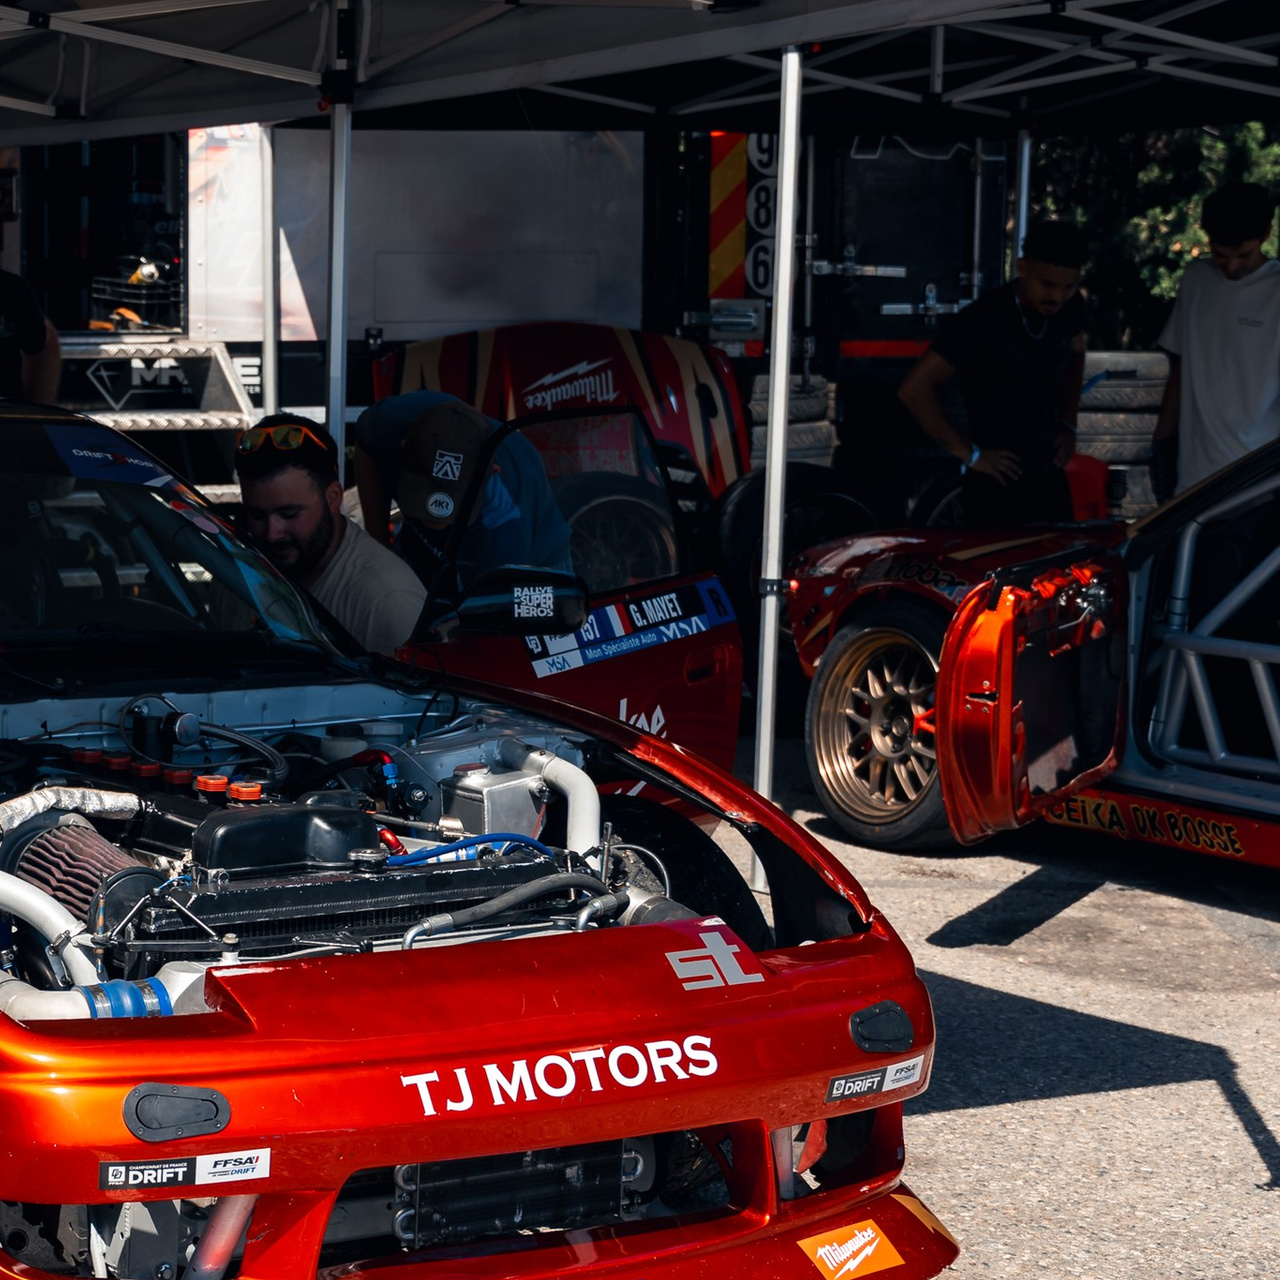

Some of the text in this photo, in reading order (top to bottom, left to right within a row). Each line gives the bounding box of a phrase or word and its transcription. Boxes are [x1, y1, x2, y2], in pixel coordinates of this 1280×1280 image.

[521, 368, 620, 412] Milwaukee
[514, 586, 554, 598] RALLYE
[520, 593, 554, 610] SUPER
[642, 592, 683, 624] MAYET
[514, 604, 554, 618] HEROS
[586, 632, 657, 660] Mon Spécialiste Auto
[1131, 804, 1167, 841] DK
[1165, 811, 1245, 857] BOSSE
[401, 1035, 719, 1116] TJ MOTORS
[894, 1063, 918, 1077] FFSA
[844, 1077, 881, 1096] DRIFT
[213, 1156, 257, 1169] FFSA
[230, 1166, 257, 1176] DRIFT
[129, 1168, 188, 1185] DRIFT
[816, 1226, 876, 1271] Milwaukee
